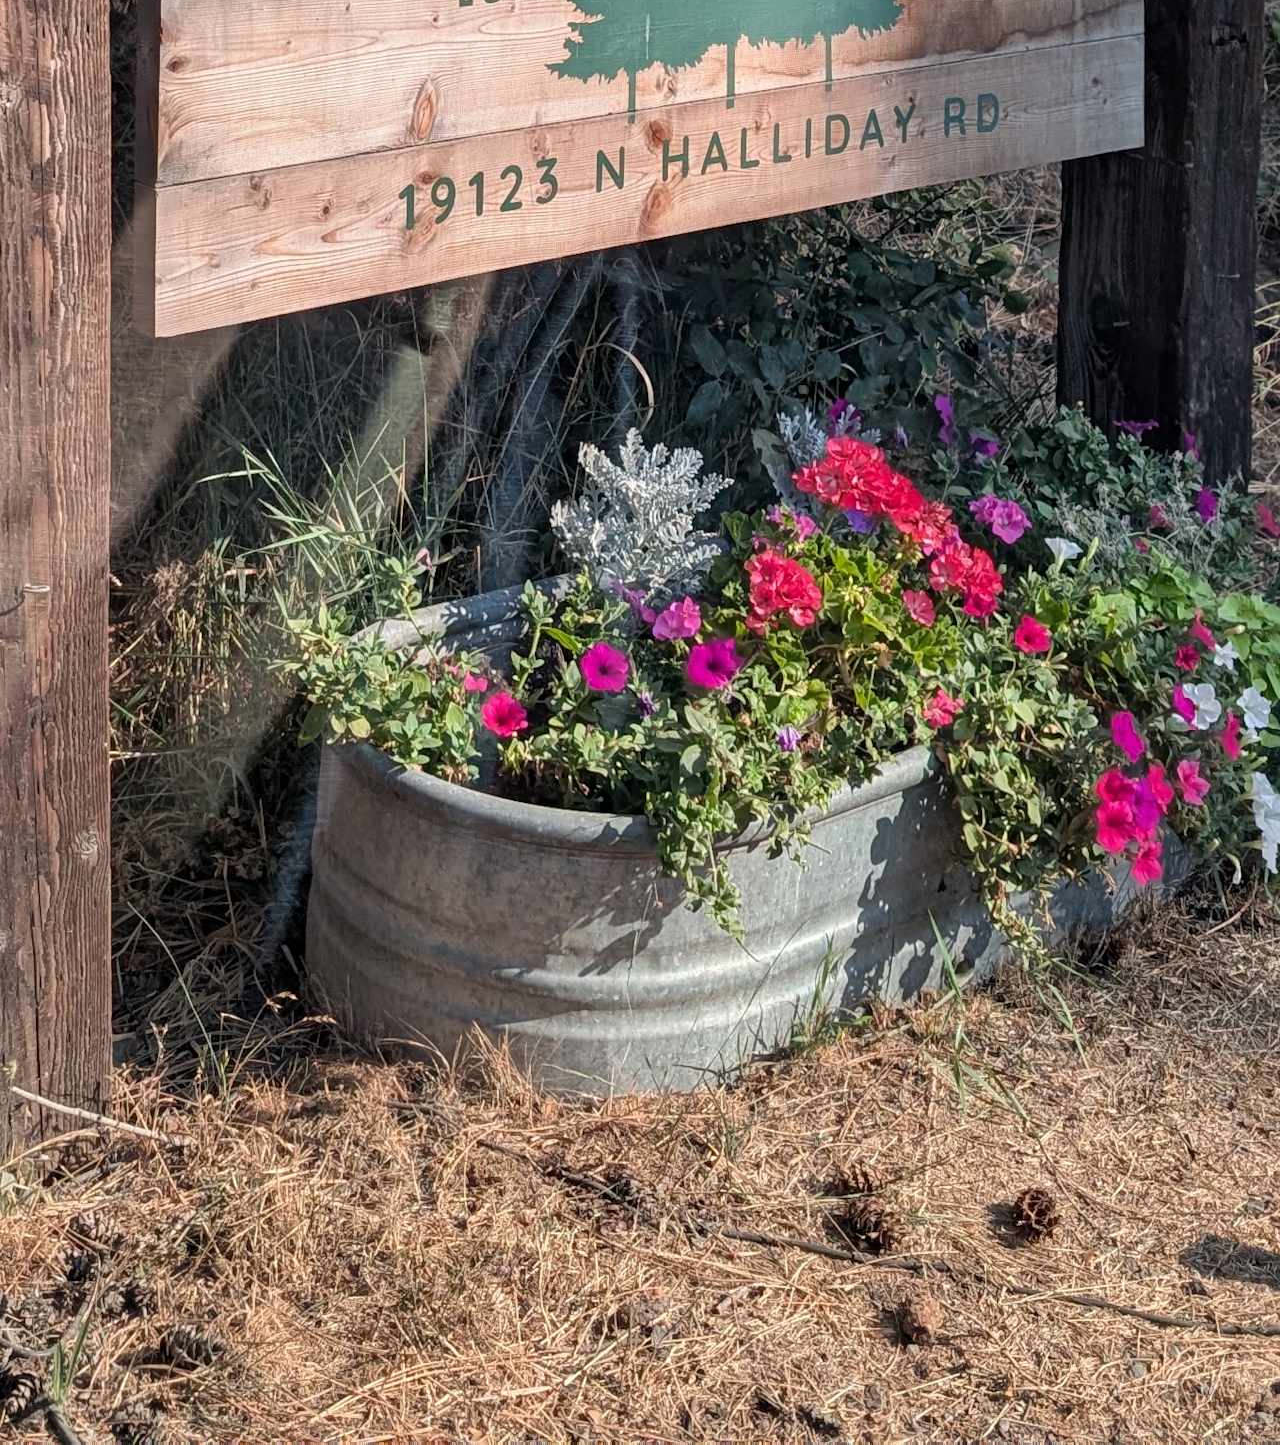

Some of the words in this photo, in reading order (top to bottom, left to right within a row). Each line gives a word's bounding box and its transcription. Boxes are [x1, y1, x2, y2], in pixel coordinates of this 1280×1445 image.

[398, 157, 558, 230] 19123
[596, 145, 626, 191] N
[662, 105, 916, 182] HALLIDAY
[943, 92, 1002, 139] RD
